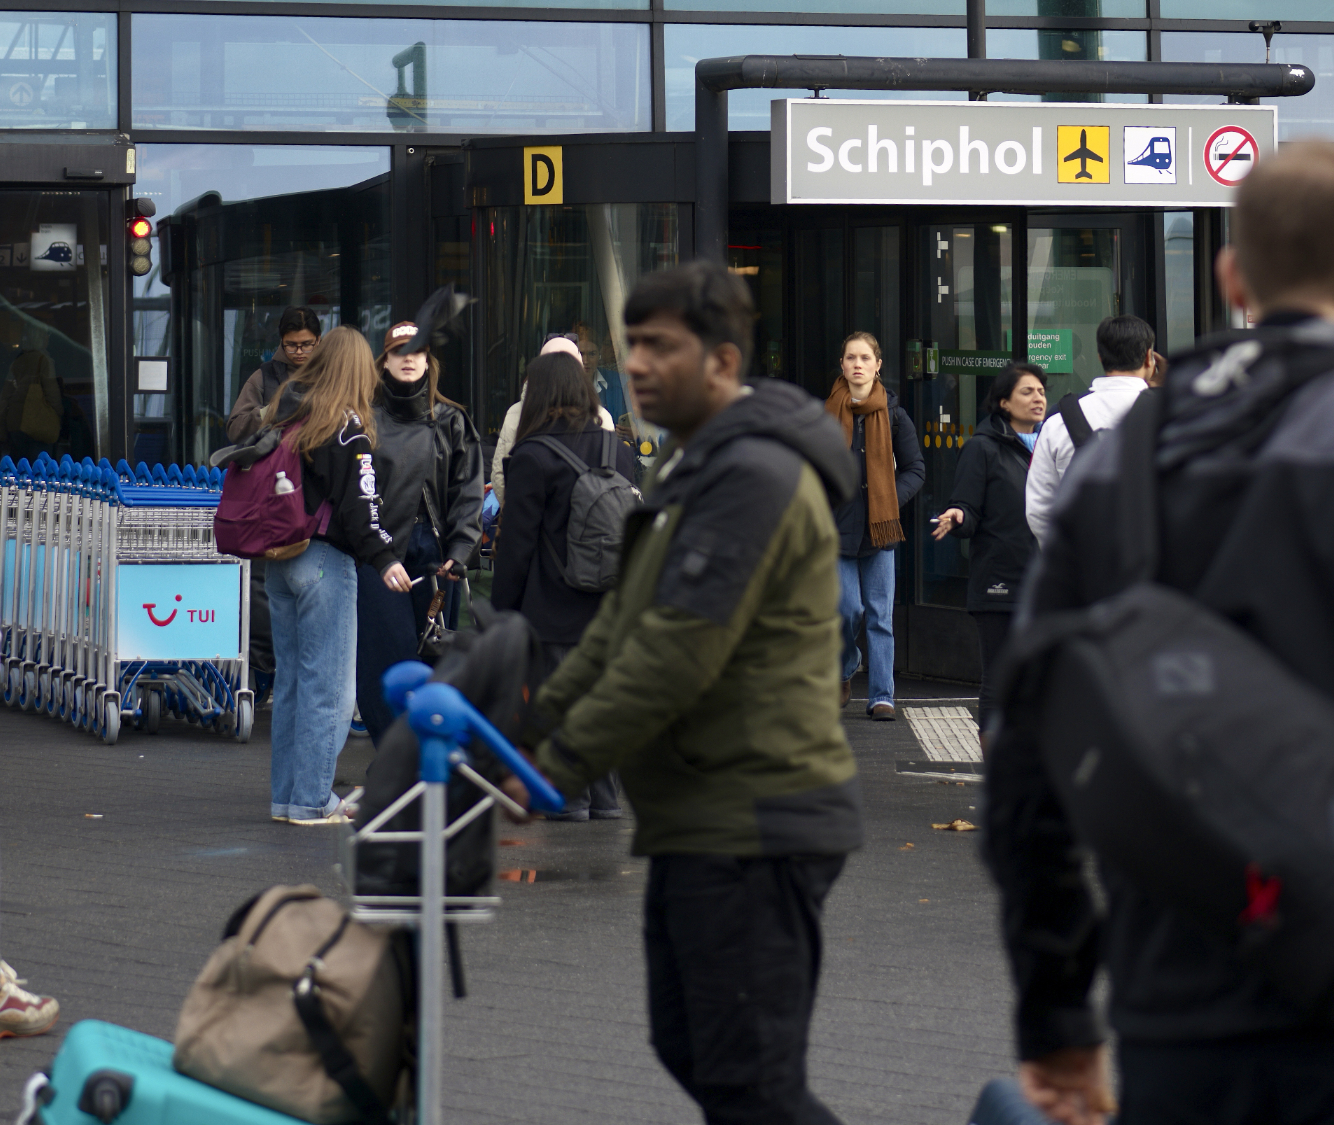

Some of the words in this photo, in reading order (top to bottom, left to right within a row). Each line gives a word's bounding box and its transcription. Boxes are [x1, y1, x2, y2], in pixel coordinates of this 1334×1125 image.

[806, 124, 1043, 186] Schiphol
[531, 153, 555, 197] D
[941, 356, 955, 366] PUSH
[955, 356, 961, 366] IN
[962, 357, 975, 367] CASE
[975, 357, 982, 367] OF
[982, 357, 1013, 368] EMERGEN
[1054, 353, 1067, 361] exit
[186, 609, 216, 623] TUI
